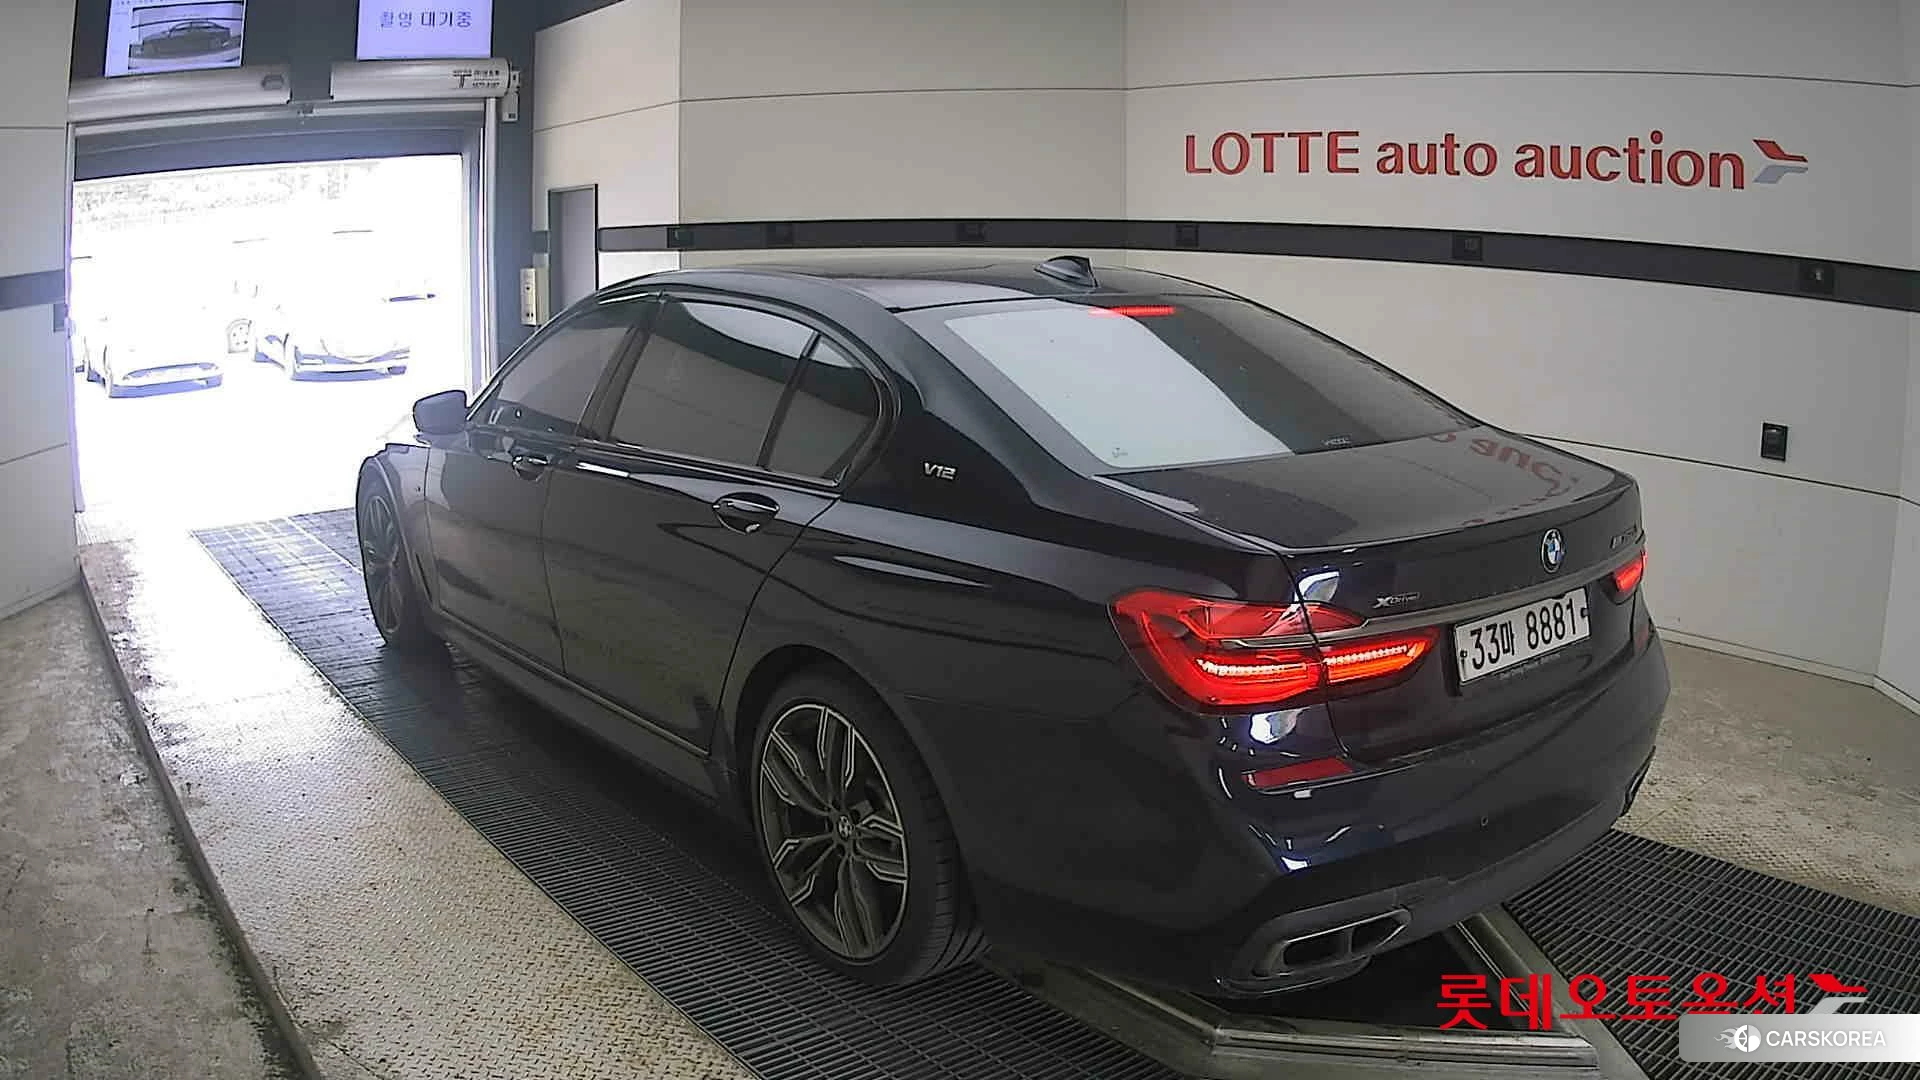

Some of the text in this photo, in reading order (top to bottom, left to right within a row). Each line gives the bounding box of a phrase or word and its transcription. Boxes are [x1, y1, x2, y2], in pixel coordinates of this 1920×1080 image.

[421, 10, 472, 28] 대기중
[1186, 130, 1745, 190] LOTTE auto auction
[924, 462, 956, 480] V12
[1469, 620, 1515, 670] 33마
[1526, 597, 1577, 650] 8881
